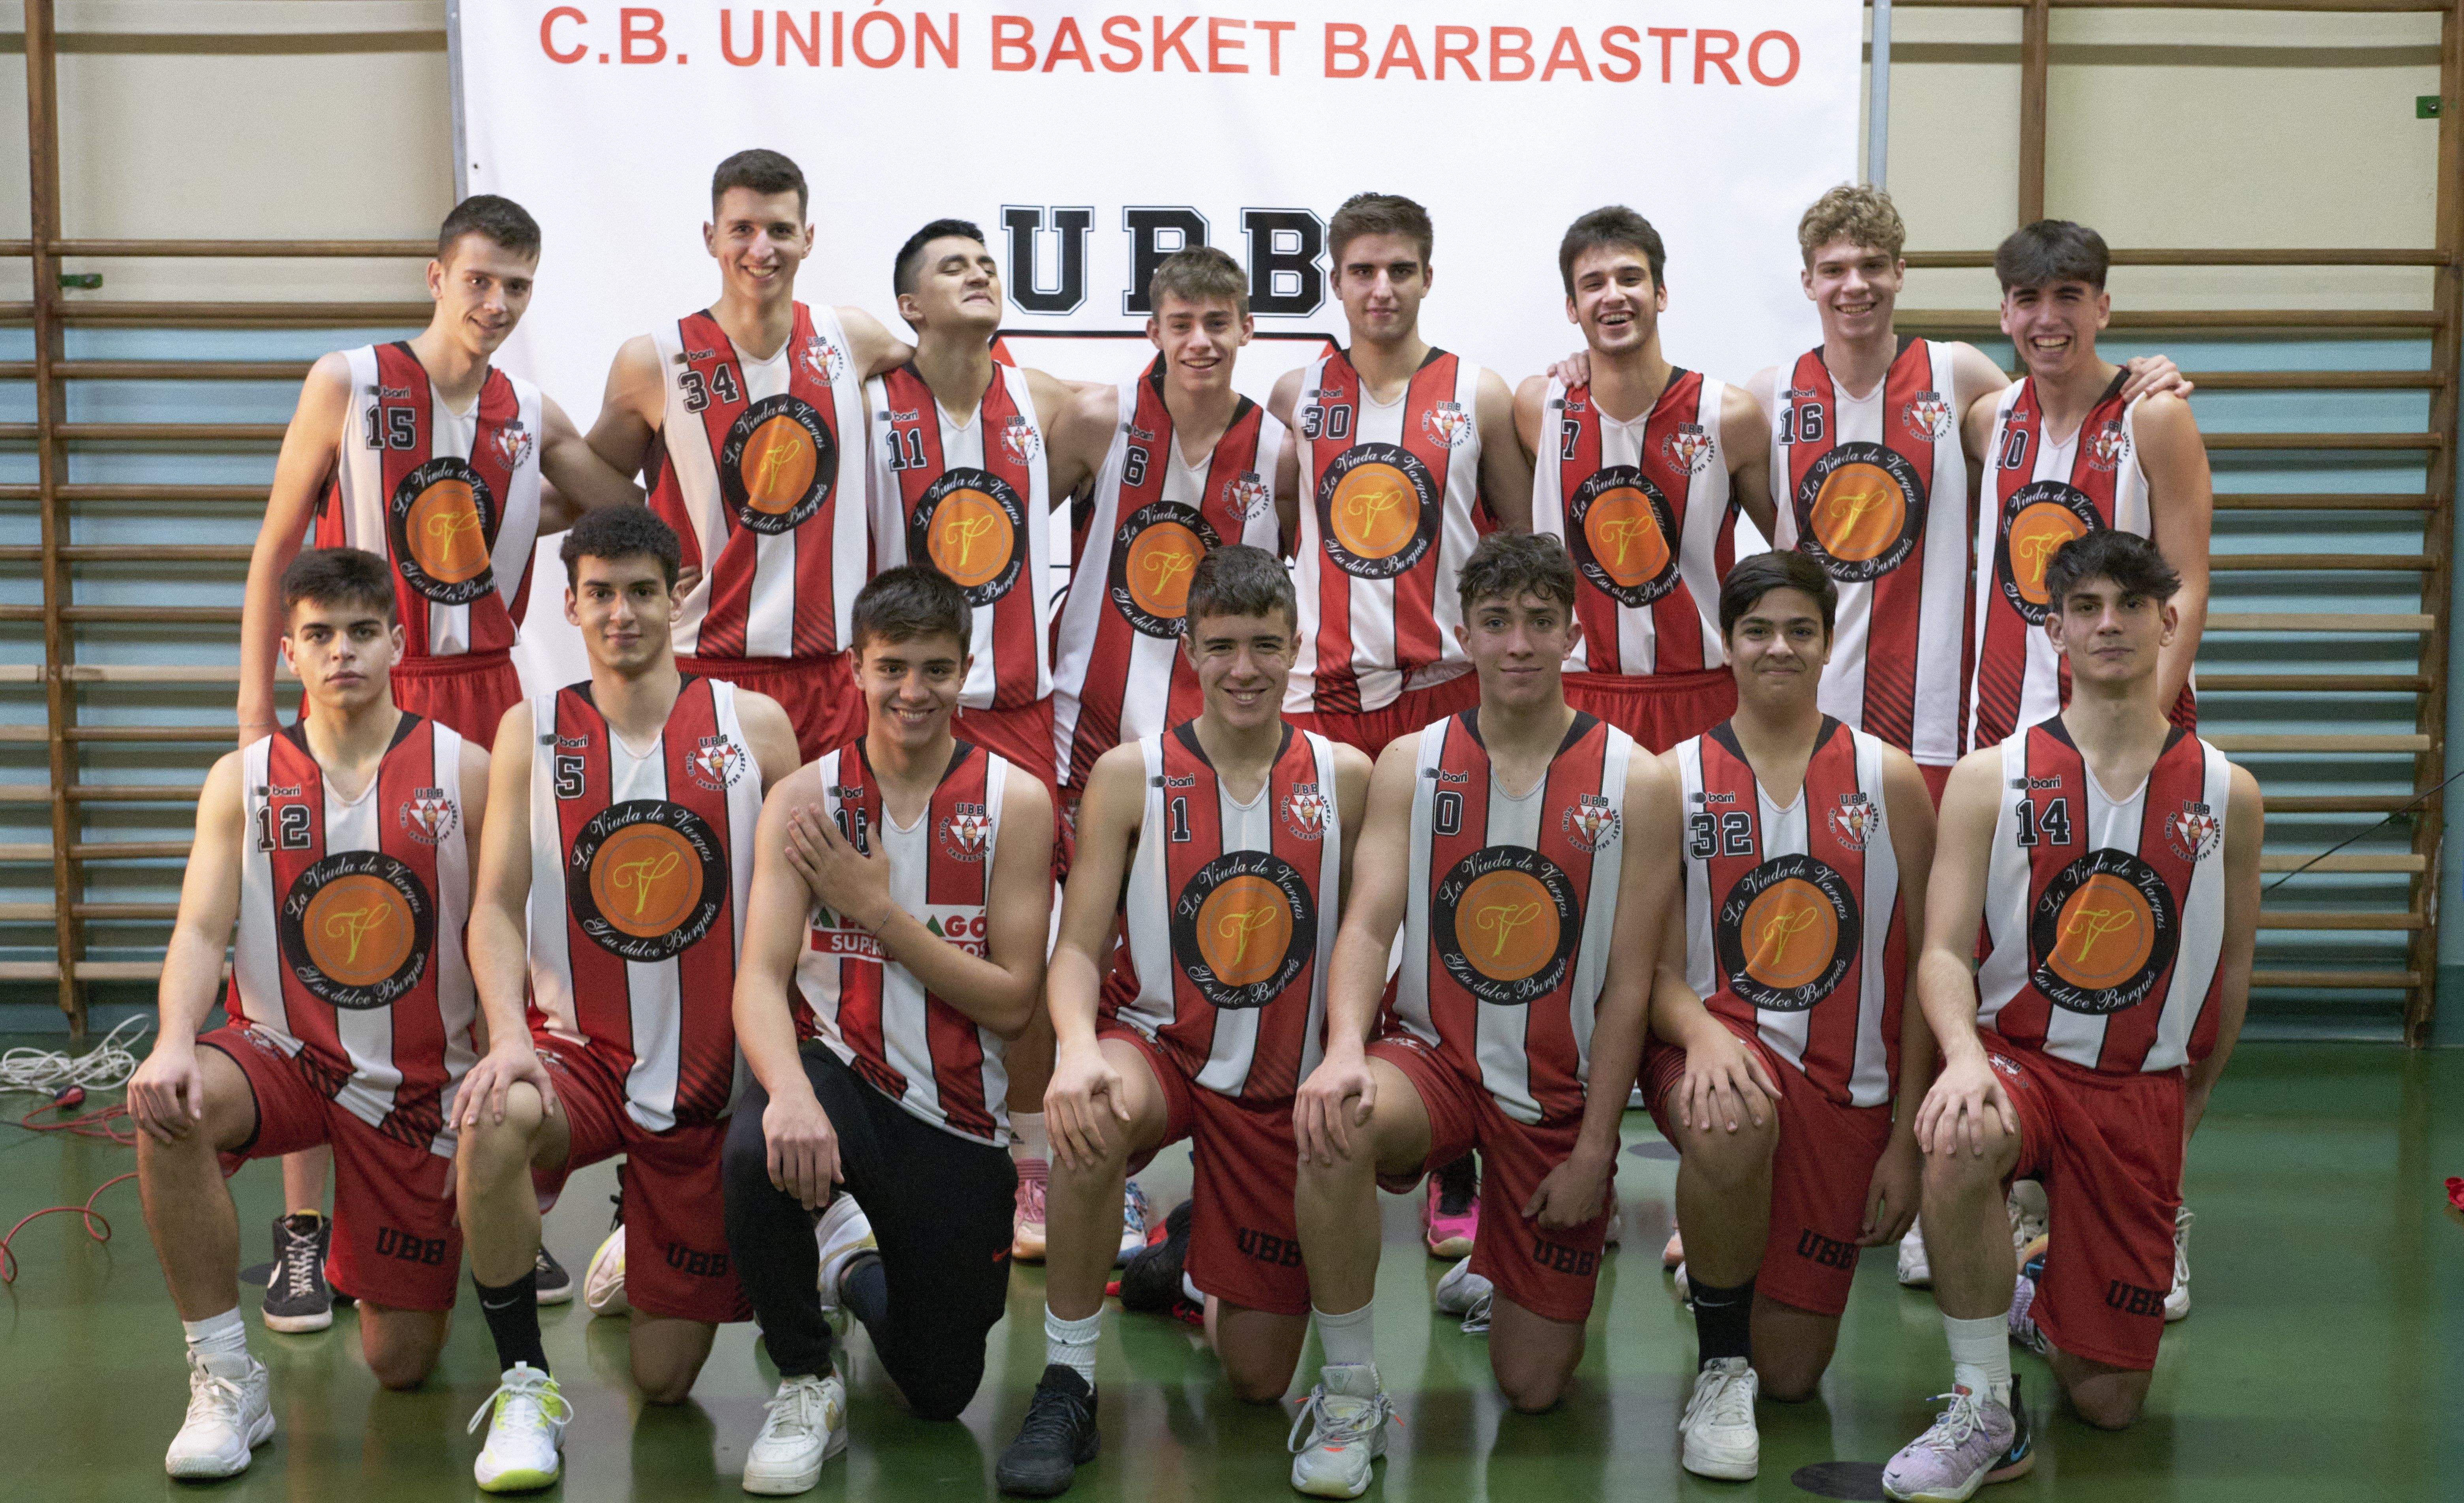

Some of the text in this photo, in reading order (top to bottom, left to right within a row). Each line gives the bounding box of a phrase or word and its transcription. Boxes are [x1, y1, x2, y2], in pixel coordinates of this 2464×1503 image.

[540, 0, 1800, 87] C.B. UNIÓN BASKET BARBASTRO
[678, 363, 740, 413] 34
[366, 404, 416, 451] 15
[1302, 404, 1352, 440] 30
[1561, 419, 1581, 460] 7
[1779, 403, 1824, 445] 16
[886, 428, 928, 471] 11
[1122, 445, 1149, 487] 6
[699, 734, 728, 747] UBB
[415, 788, 443, 798] UBB
[556, 755, 585, 799] 5
[1293, 783, 1318, 794] UBB
[1840, 792, 1867, 804] UBB
[955, 802, 985, 815] UBB
[1171, 796, 1191, 842] 1
[1434, 791, 1462, 836] 0
[1580, 794, 1609, 806] UBB
[2182, 800, 2210, 814] UBB
[257, 804, 312, 853] 12
[572, 805, 712, 872] La Viuda de Vargas
[1690, 812, 1753, 859] 32
[2016, 798, 2071, 847] 14
[285, 857, 421, 921] La Viuda de Vargas
[1178, 857, 1304, 920] La Viuda de Vargas
[1439, 850, 1568, 917] La Viuda de Vargas
[1722, 860, 1848, 926] La Viuda de Vargas
[2040, 890, 2064, 916] La
[2112, 859, 2130, 876] de
[2138, 869, 2165, 929] Vargas
[376, 1227, 446, 1264] UBB
[667, 1243, 727, 1277] UBB
[1238, 1227, 1302, 1266] UBB
[1533, 1236, 1594, 1276] UBB
